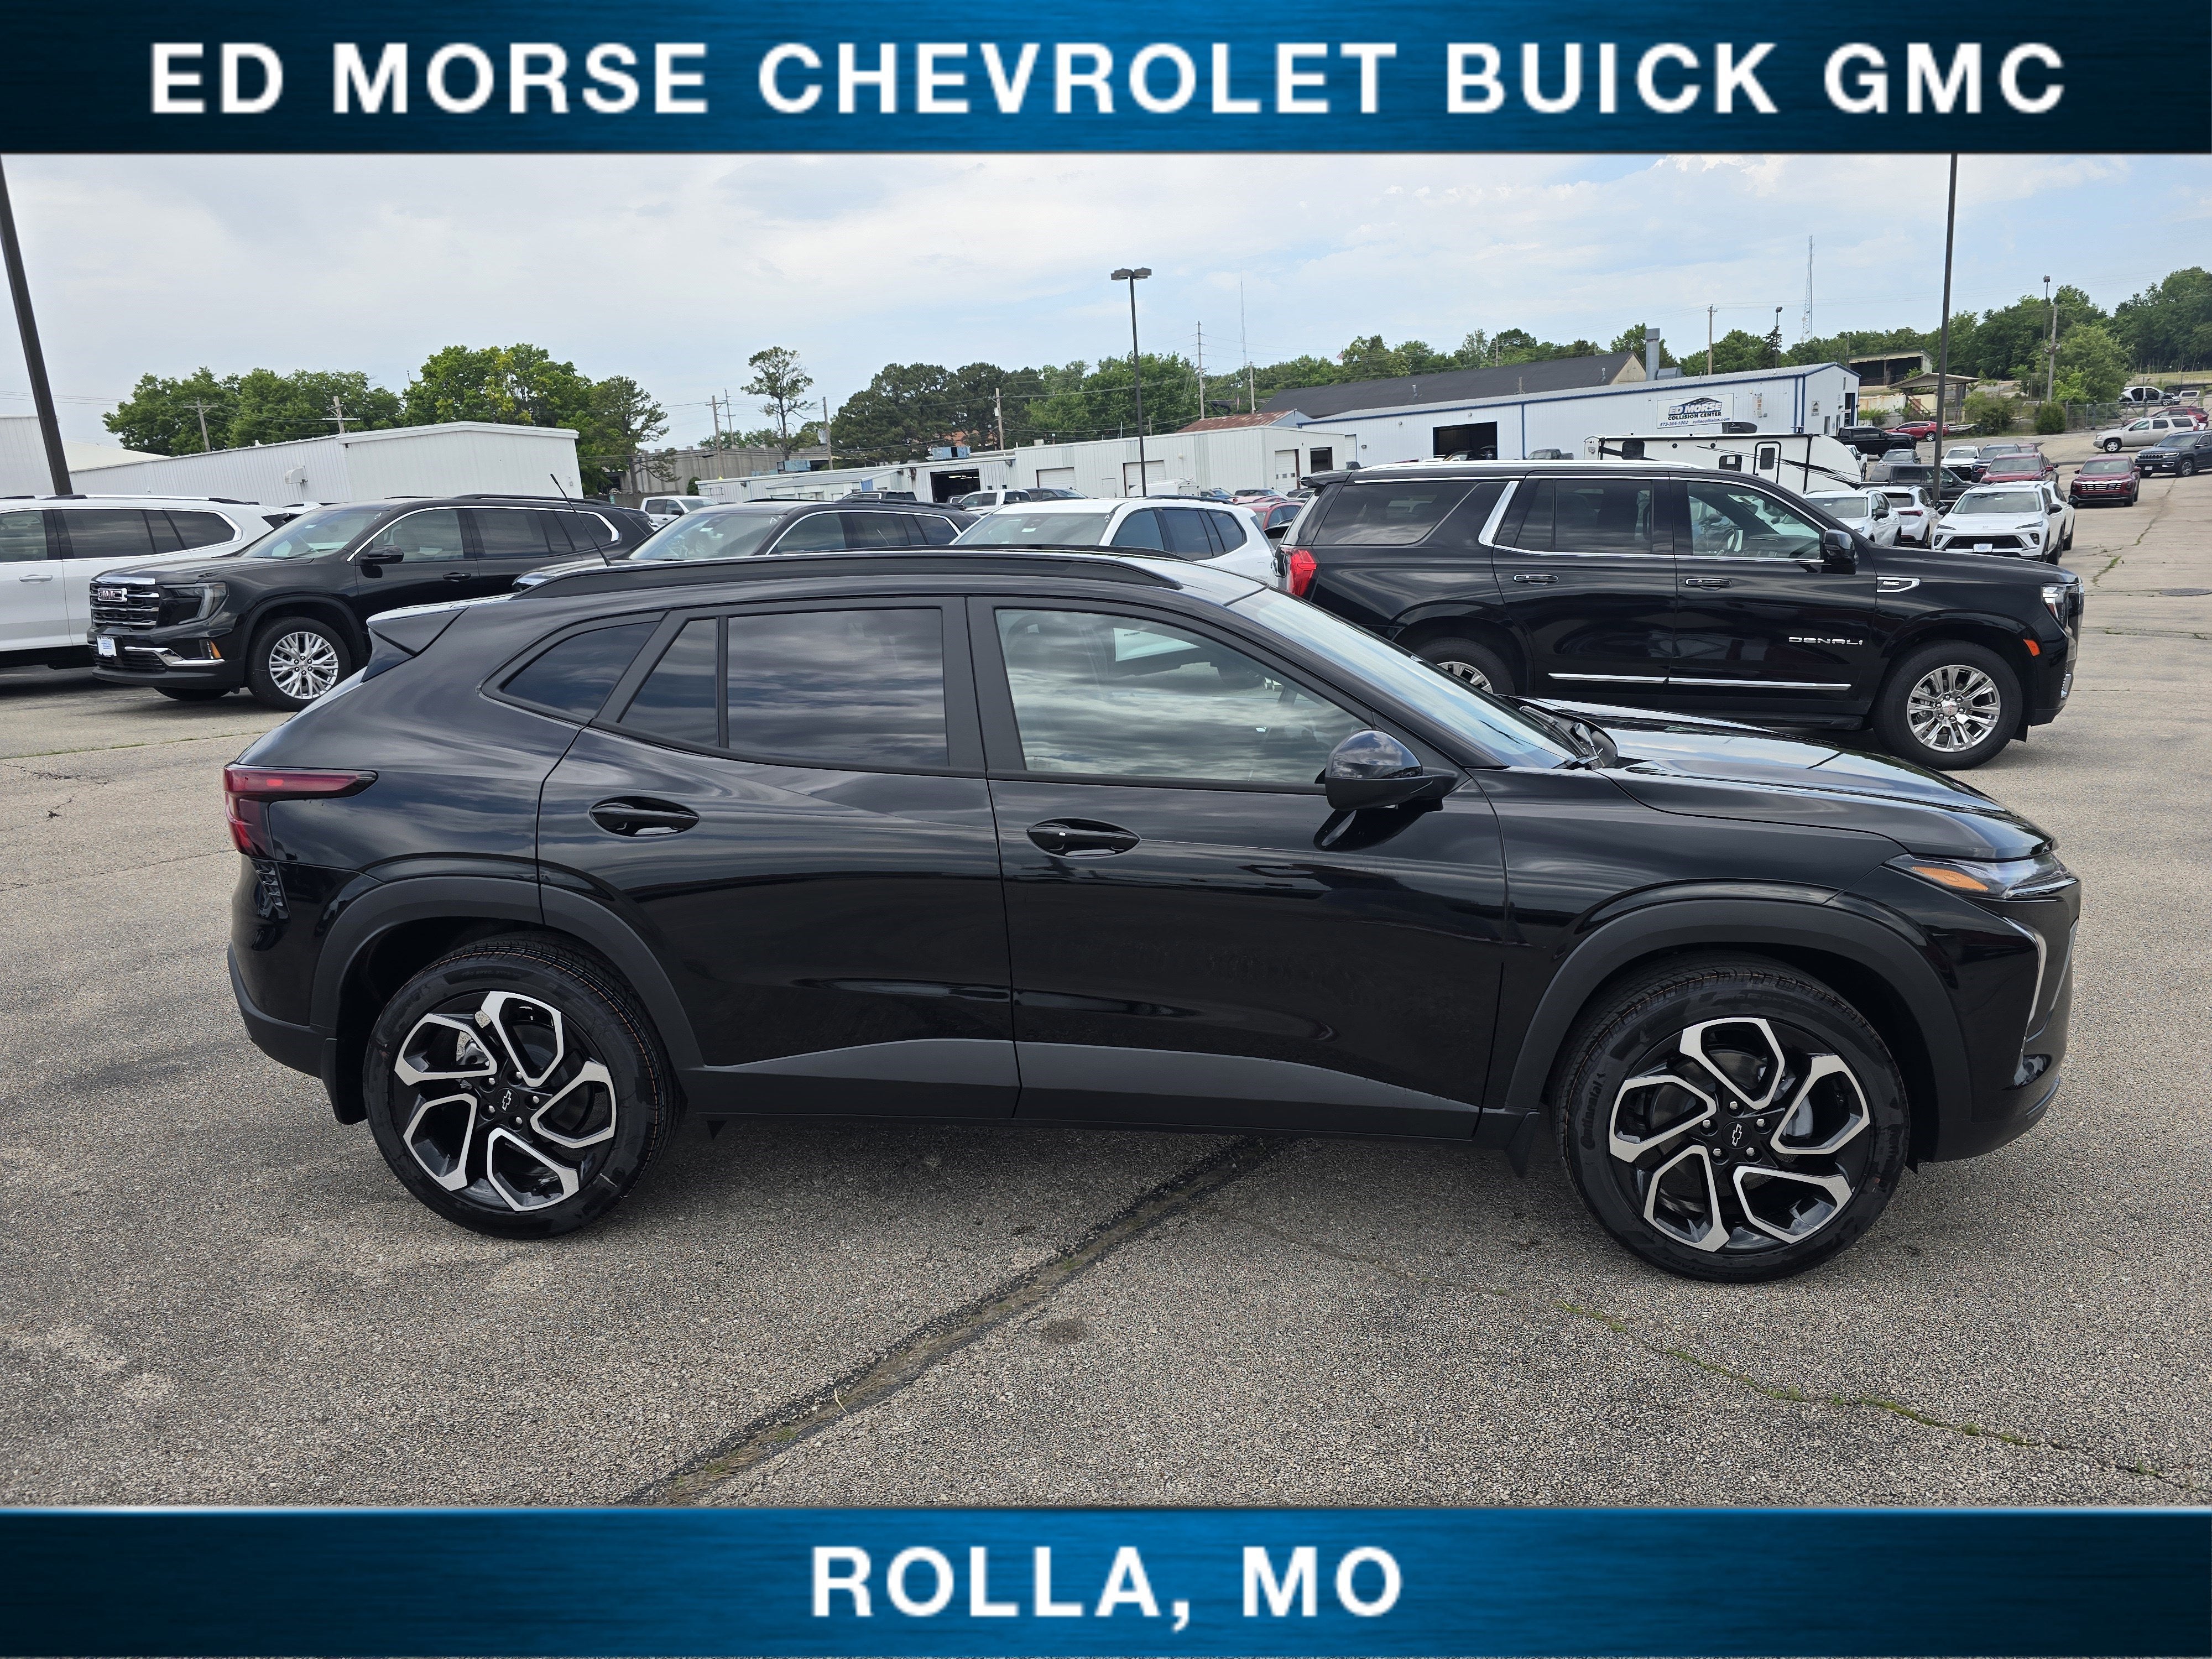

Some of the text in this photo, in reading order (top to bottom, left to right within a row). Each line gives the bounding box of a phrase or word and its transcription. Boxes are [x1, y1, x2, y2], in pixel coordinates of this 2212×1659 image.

[1669, 402, 1722, 415] ED MORSE
[98, 588, 123, 602] GMC
[1788, 637, 1863, 645] DENALI
